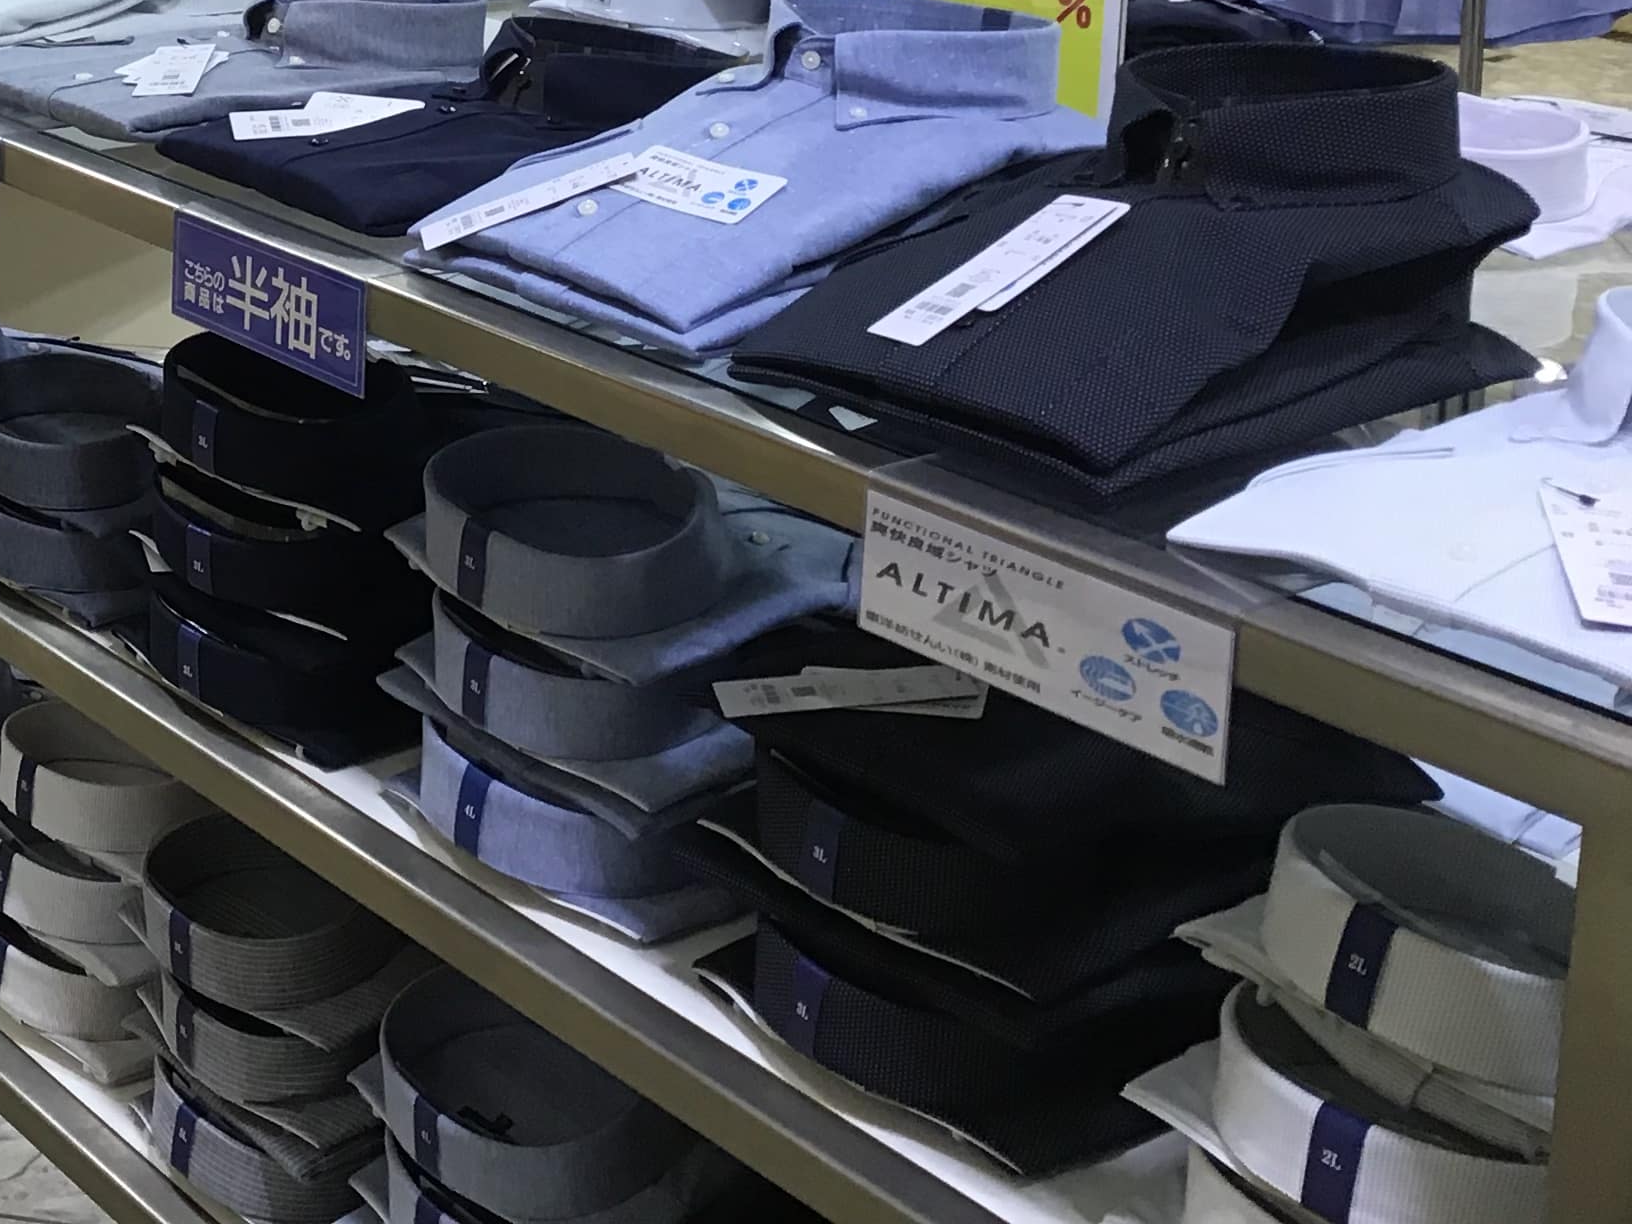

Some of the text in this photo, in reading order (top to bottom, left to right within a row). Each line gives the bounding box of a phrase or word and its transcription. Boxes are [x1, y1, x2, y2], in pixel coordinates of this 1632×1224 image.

[639, 167, 702, 192] ALTIMA
[184, 259, 225, 292] こちらの
[872, 507, 1064, 590] FUNCTIONAL TRIANGLE
[876, 562, 1050, 649] ALTIMA
[1348, 953, 1367, 975] 2L
[1321, 1149, 1341, 1170] 2L
